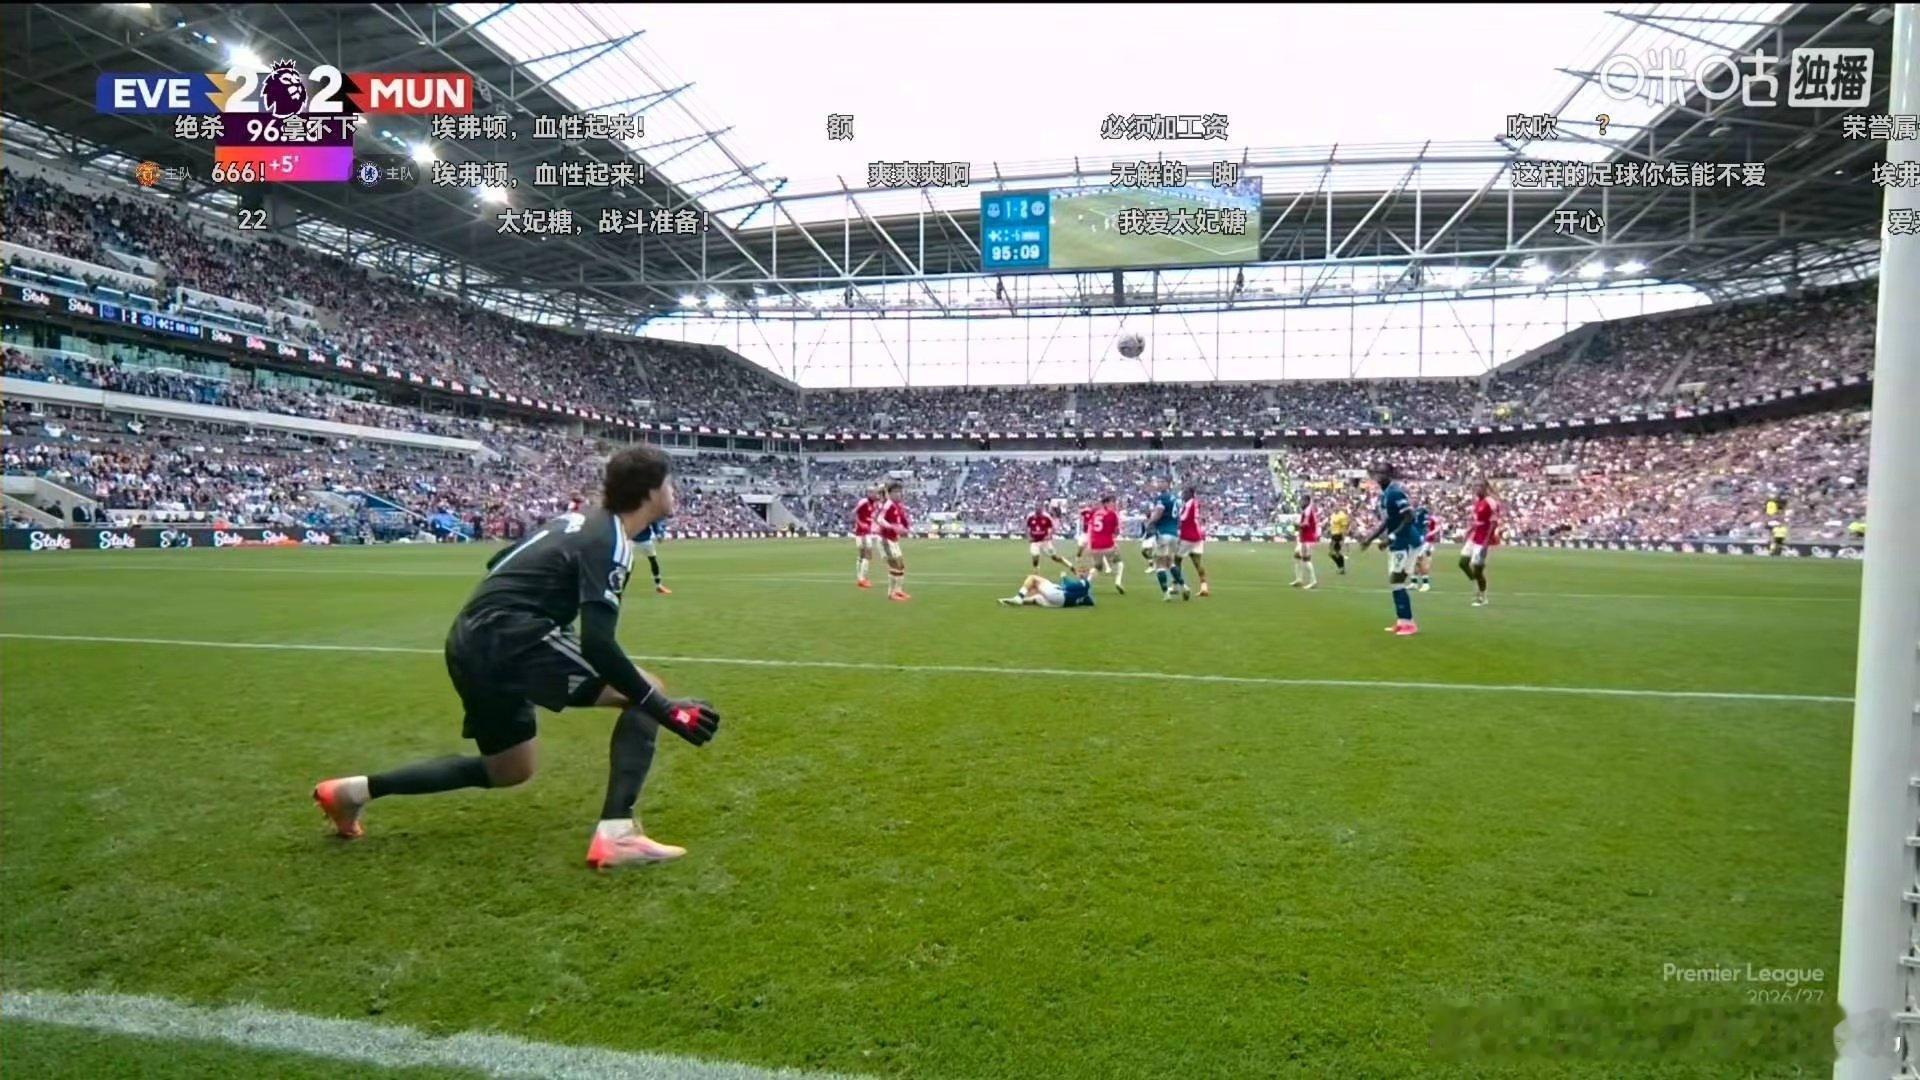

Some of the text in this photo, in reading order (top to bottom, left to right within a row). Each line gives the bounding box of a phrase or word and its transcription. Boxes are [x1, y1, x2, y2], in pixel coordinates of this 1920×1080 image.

[991, 245, 1040, 260] 95:09
[1093, 515, 1104, 533] 5
[30, 530, 72, 550] Stake
[99, 530, 136, 548] Stake
